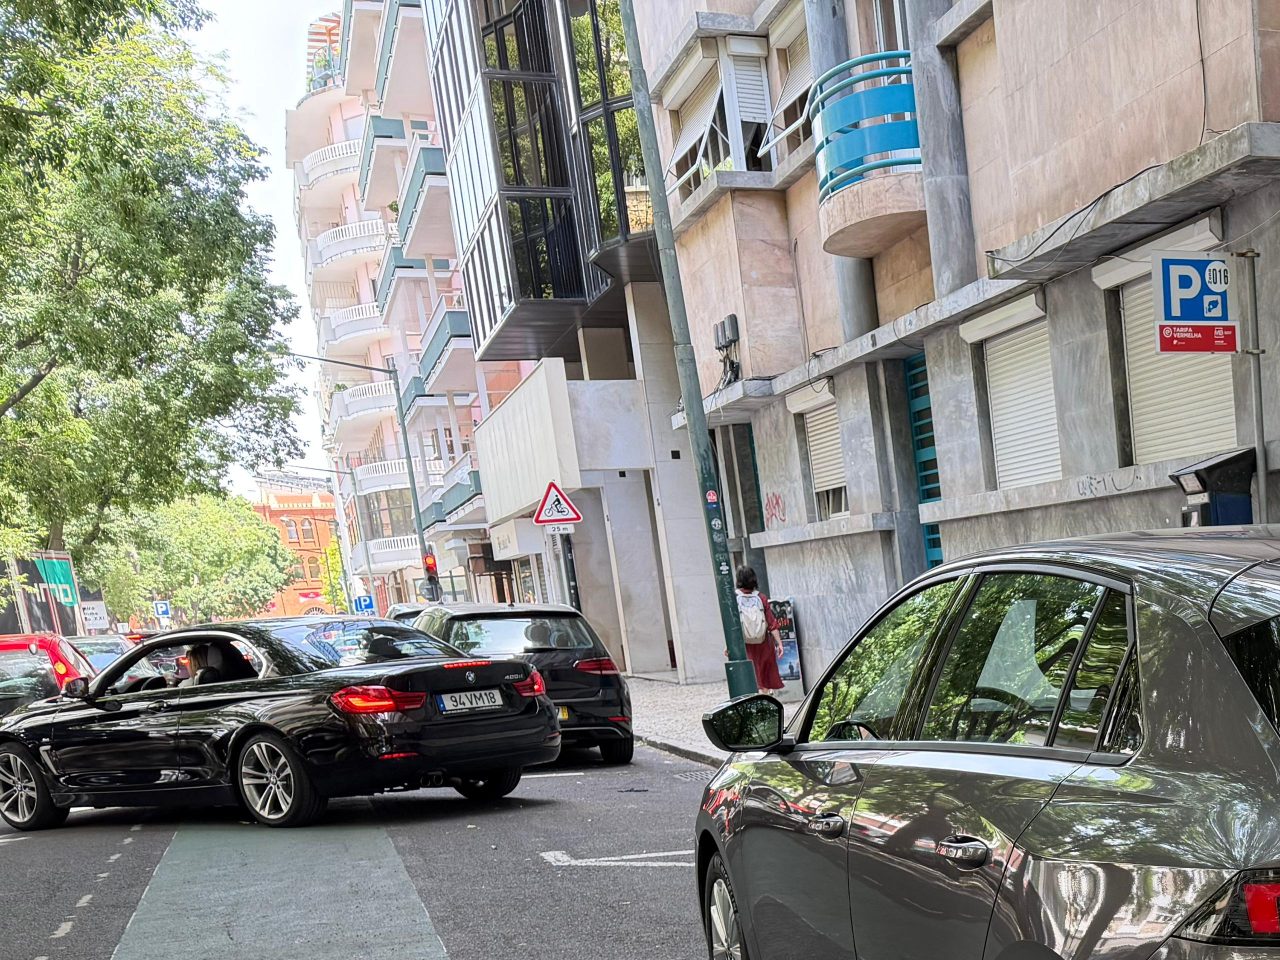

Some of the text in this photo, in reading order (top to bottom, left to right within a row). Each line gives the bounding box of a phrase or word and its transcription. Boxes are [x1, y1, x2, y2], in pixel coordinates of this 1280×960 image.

[1212, 268, 1229, 285] 016
[1169, 265, 1201, 316] P
[156, 603, 166, 615] P
[360, 596, 370, 609] P
[450, 691, 497, 708] 94VM18
